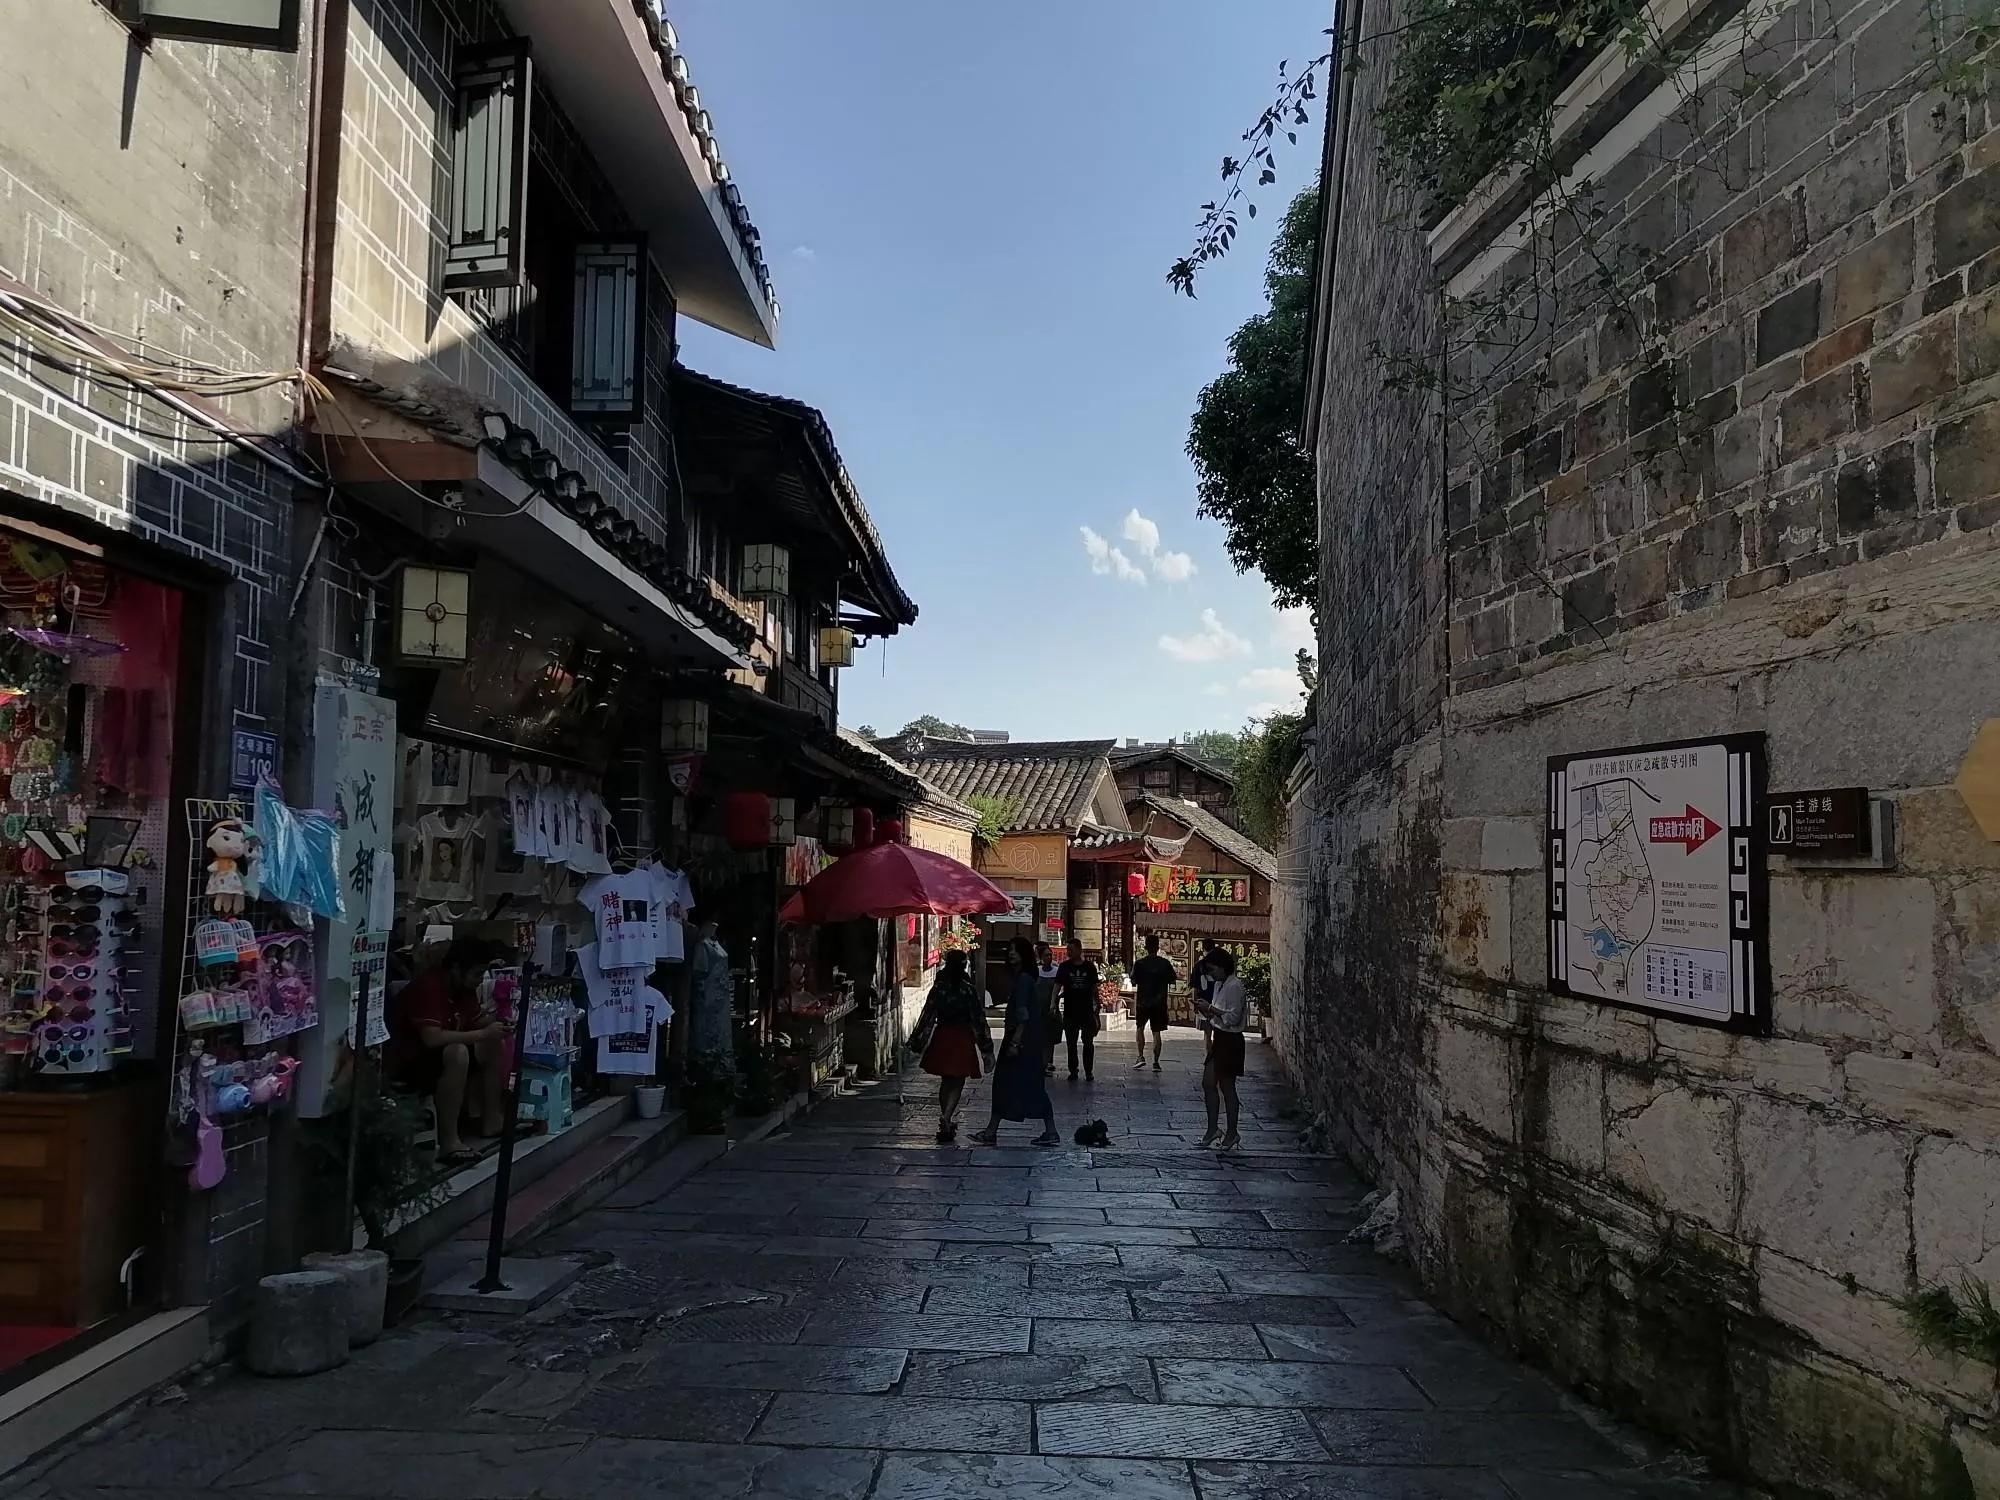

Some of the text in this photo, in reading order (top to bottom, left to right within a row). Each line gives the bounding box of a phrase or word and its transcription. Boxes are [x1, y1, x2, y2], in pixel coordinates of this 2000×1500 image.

[351, 715, 384, 743] 正宗
[1588, 752, 1699, 777] 青岩古镇景区应急疏散导引图
[1795, 797, 1833, 813] 主游线
[1651, 820, 1692, 838] 应急疏散方向
[349, 768, 378, 936] 成都
[601, 890, 623, 931] 赌神
[610, 986, 633, 997] 酒仙
